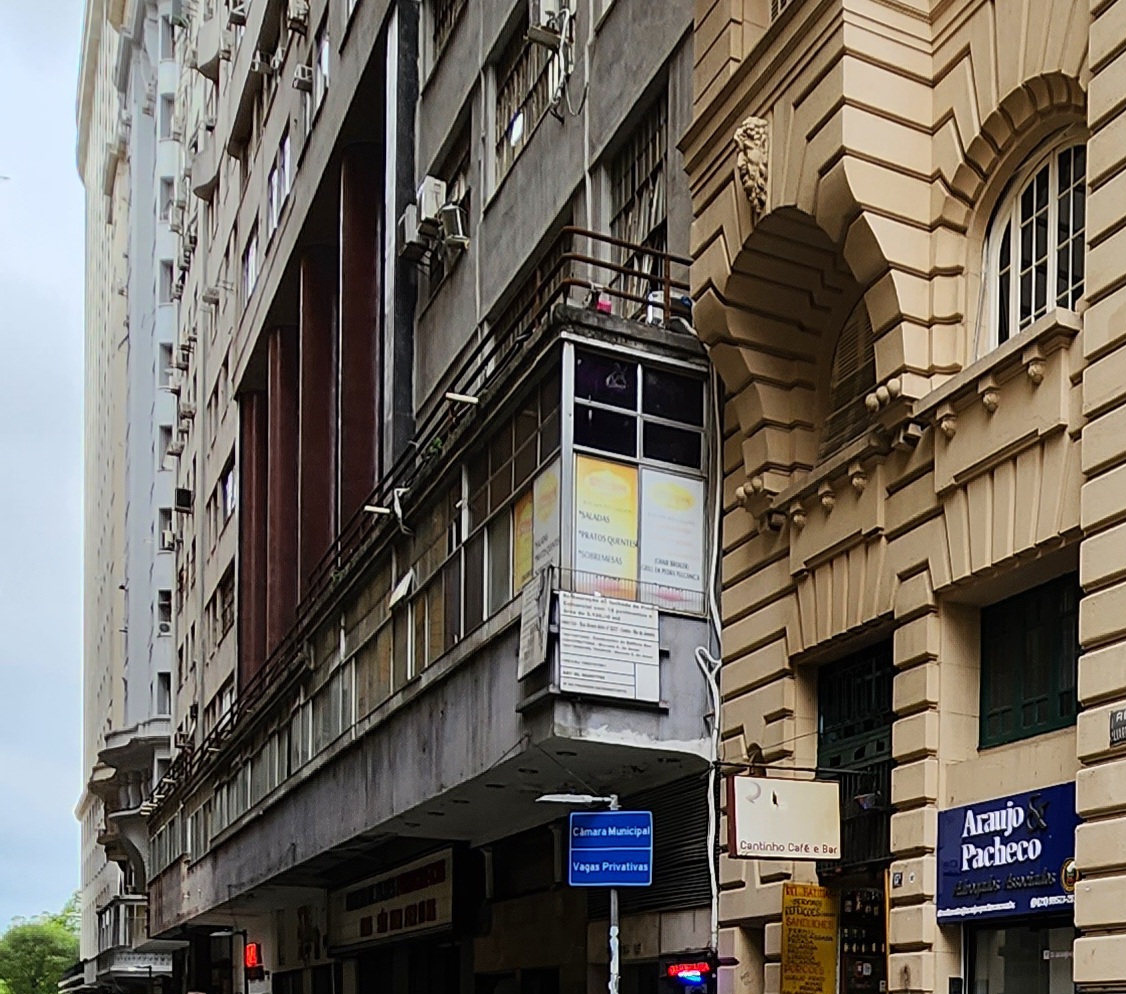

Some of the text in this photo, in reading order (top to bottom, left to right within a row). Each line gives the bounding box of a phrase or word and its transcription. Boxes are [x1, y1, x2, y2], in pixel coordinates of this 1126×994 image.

[961, 801, 1025, 838] Araujo
[608, 826, 650, 838] Municipal
[740, 840, 785, 852] Cantinho
[788, 843, 810, 853] Café
[822, 845, 837, 855] Bar
[961, 836, 1042, 872] Pacheco
[573, 862, 648, 874] Vagas Privativas
